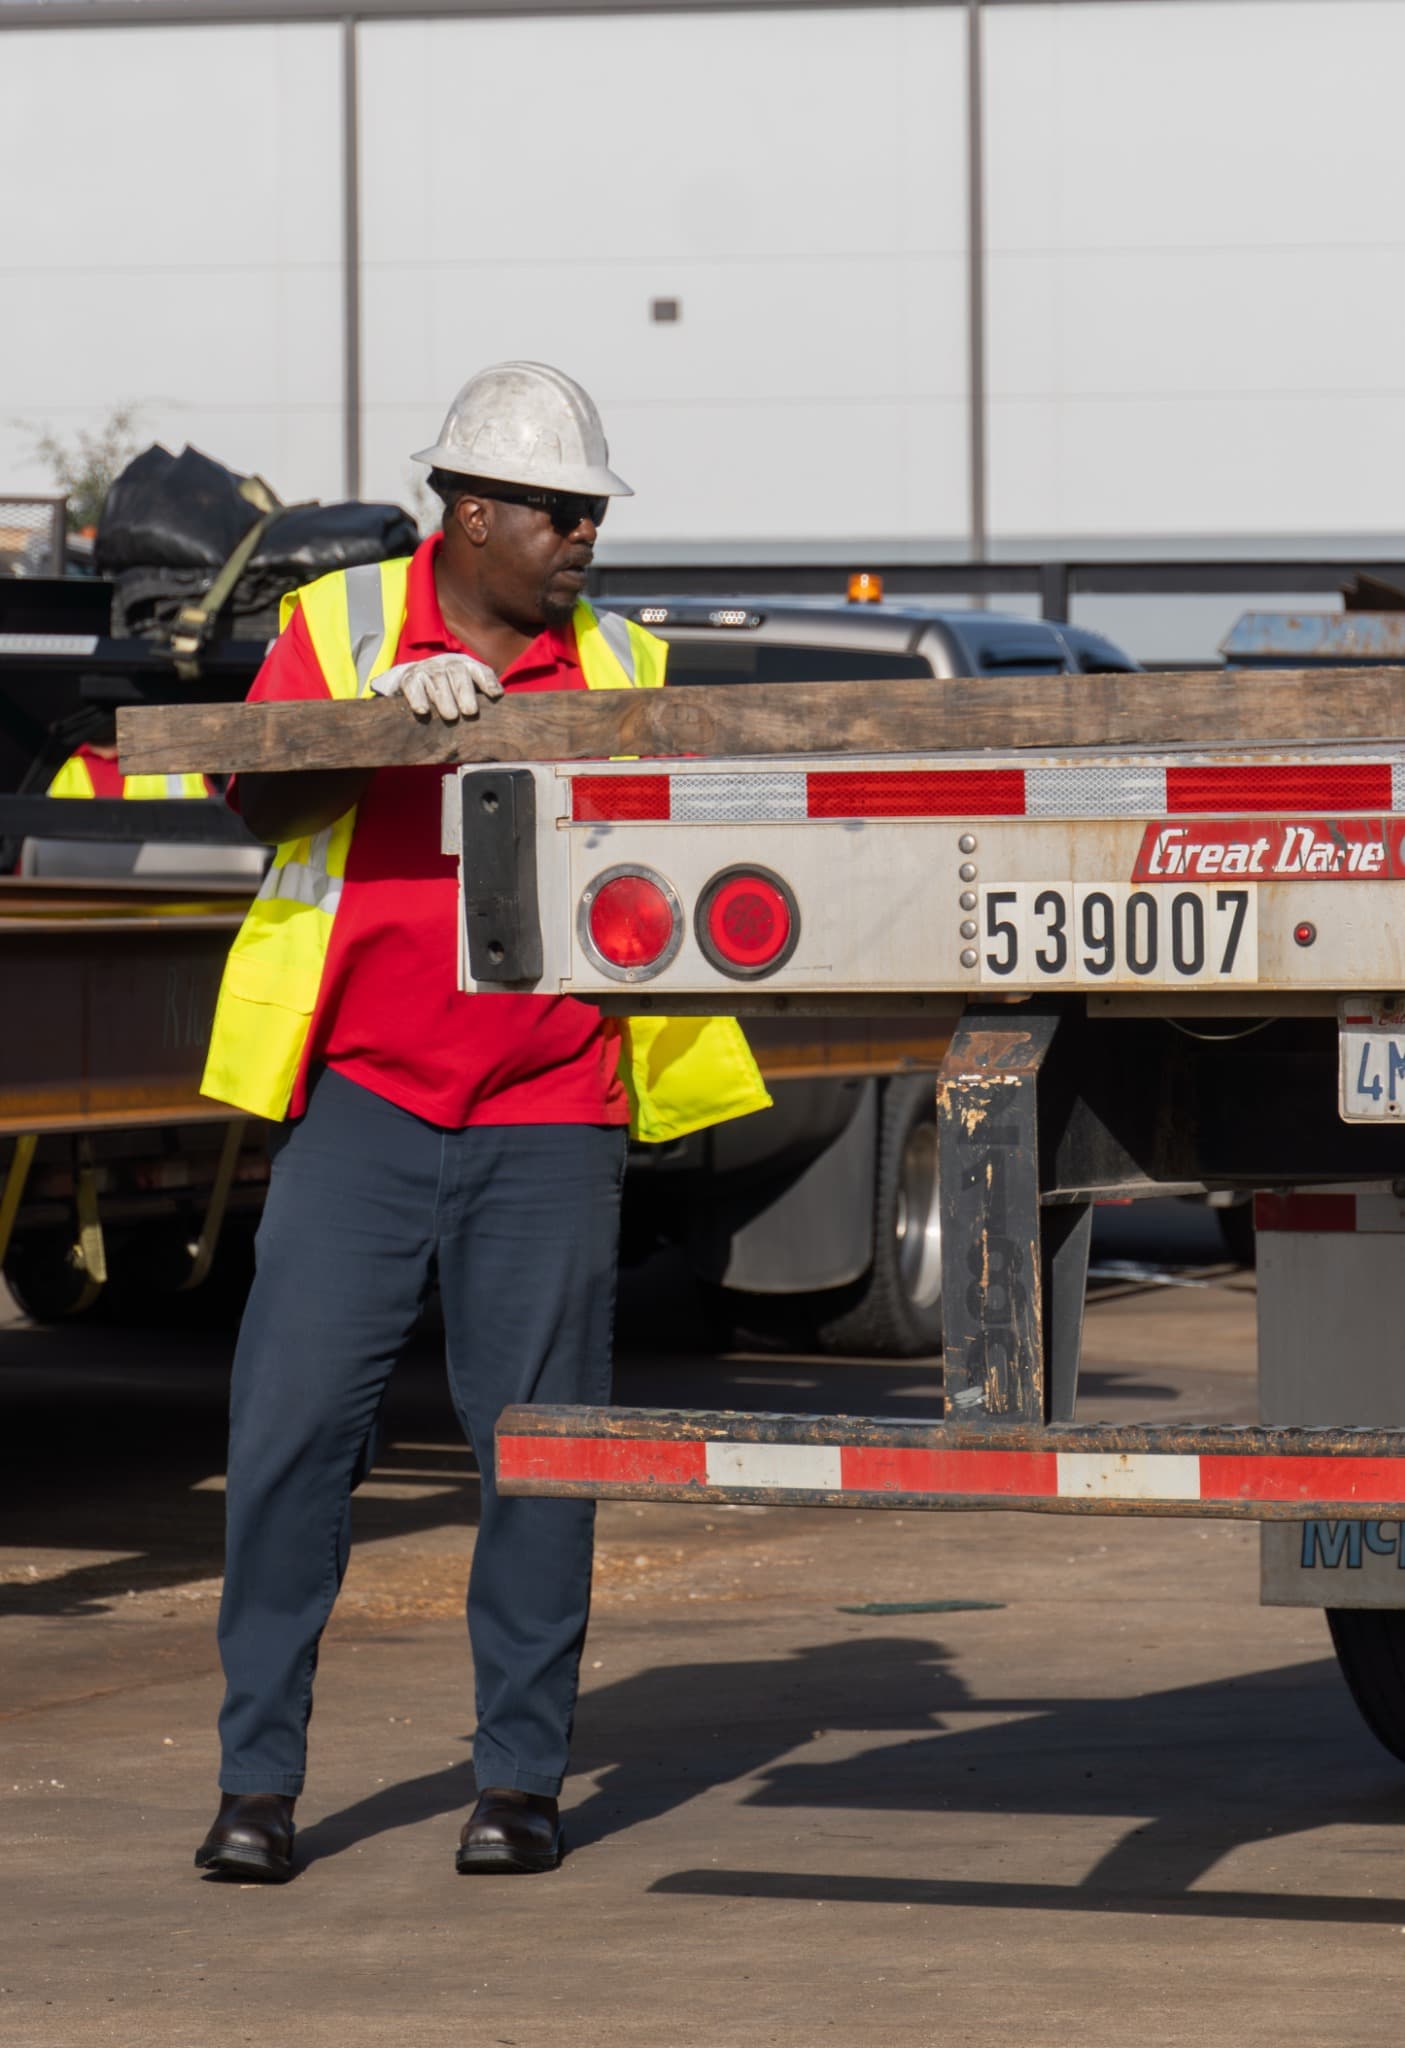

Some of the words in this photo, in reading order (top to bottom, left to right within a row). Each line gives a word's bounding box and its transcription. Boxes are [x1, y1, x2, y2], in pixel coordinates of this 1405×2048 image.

[1148, 828, 1270, 874] Great
[1272, 826, 1385, 873] Dane
[986, 890, 1249, 976] 539007
